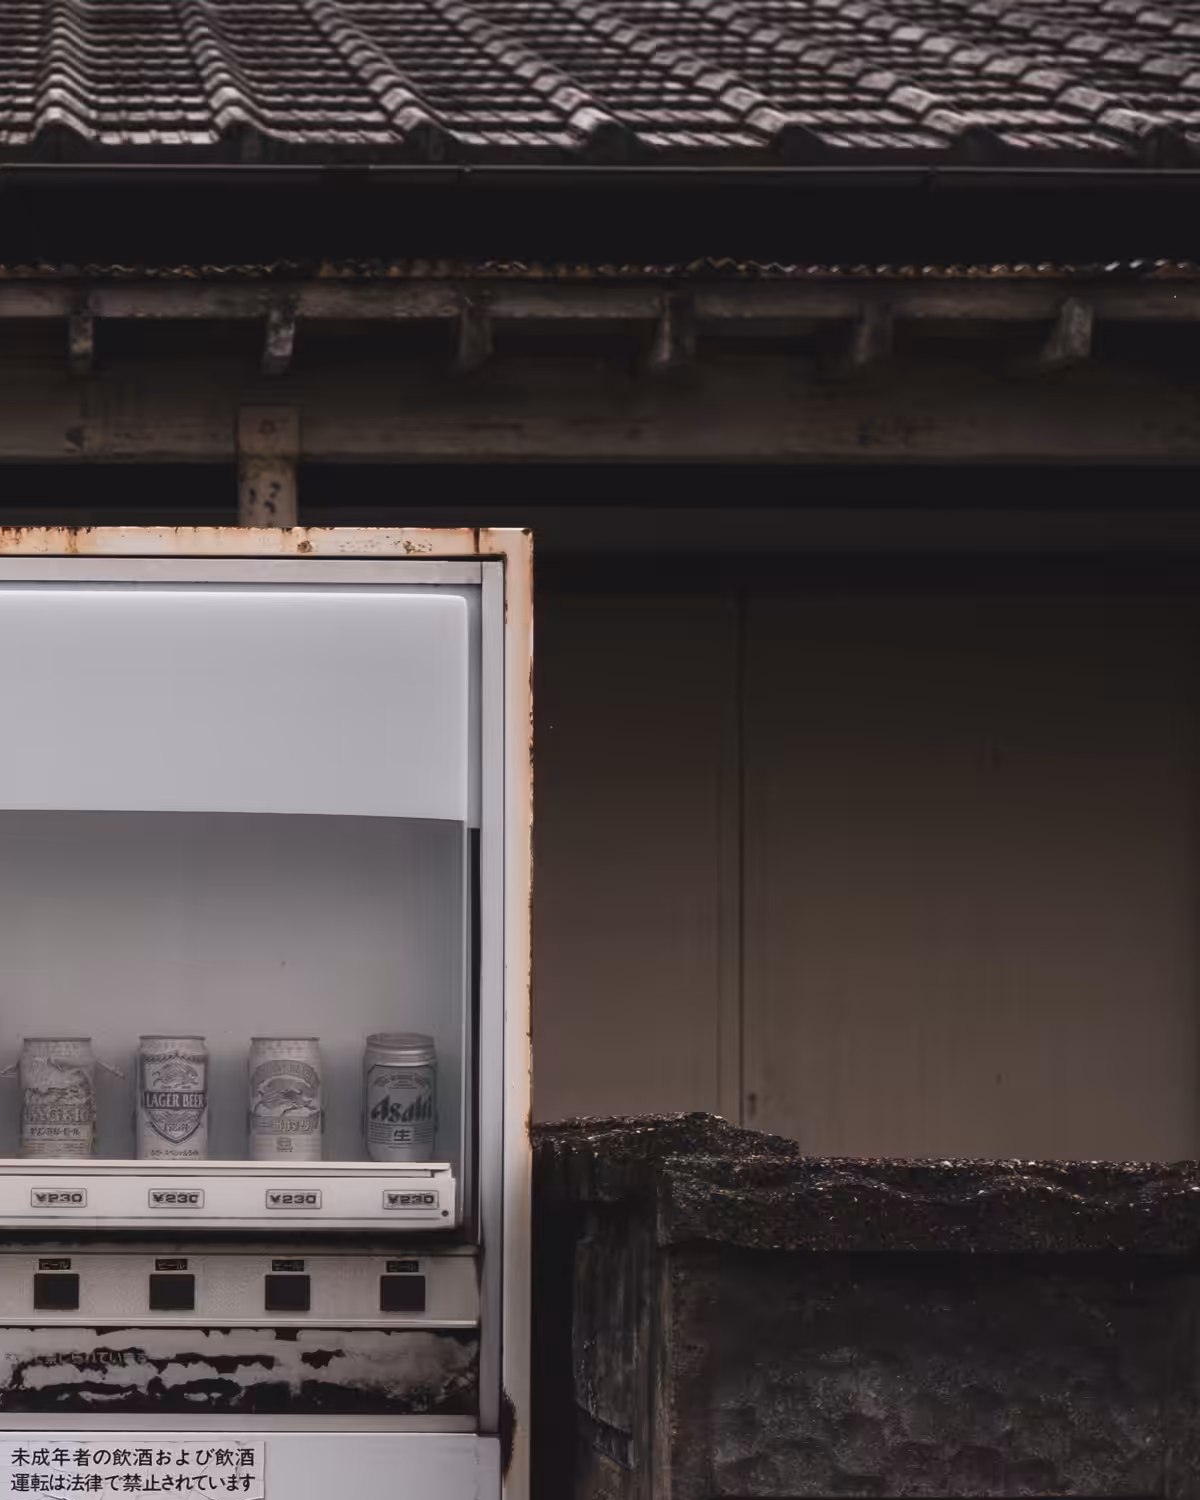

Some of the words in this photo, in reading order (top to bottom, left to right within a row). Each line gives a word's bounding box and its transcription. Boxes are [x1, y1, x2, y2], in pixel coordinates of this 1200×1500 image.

[146, 1093, 180, 1108] LAGER
[371, 1094, 432, 1122] Asahi
[35, 1192, 83, 1204] ¥230
[270, 1193, 317, 1205] ¥230
[388, 1194, 435, 1205] ¥230
[40, 1259, 69, 1269] ビール
[156, 1259, 186, 1269] ビール
[10, 1447, 255, 1467] 未成年者の飲酒および飲酒
[10, 1473, 256, 1492] 運転は法律で禁止されています
